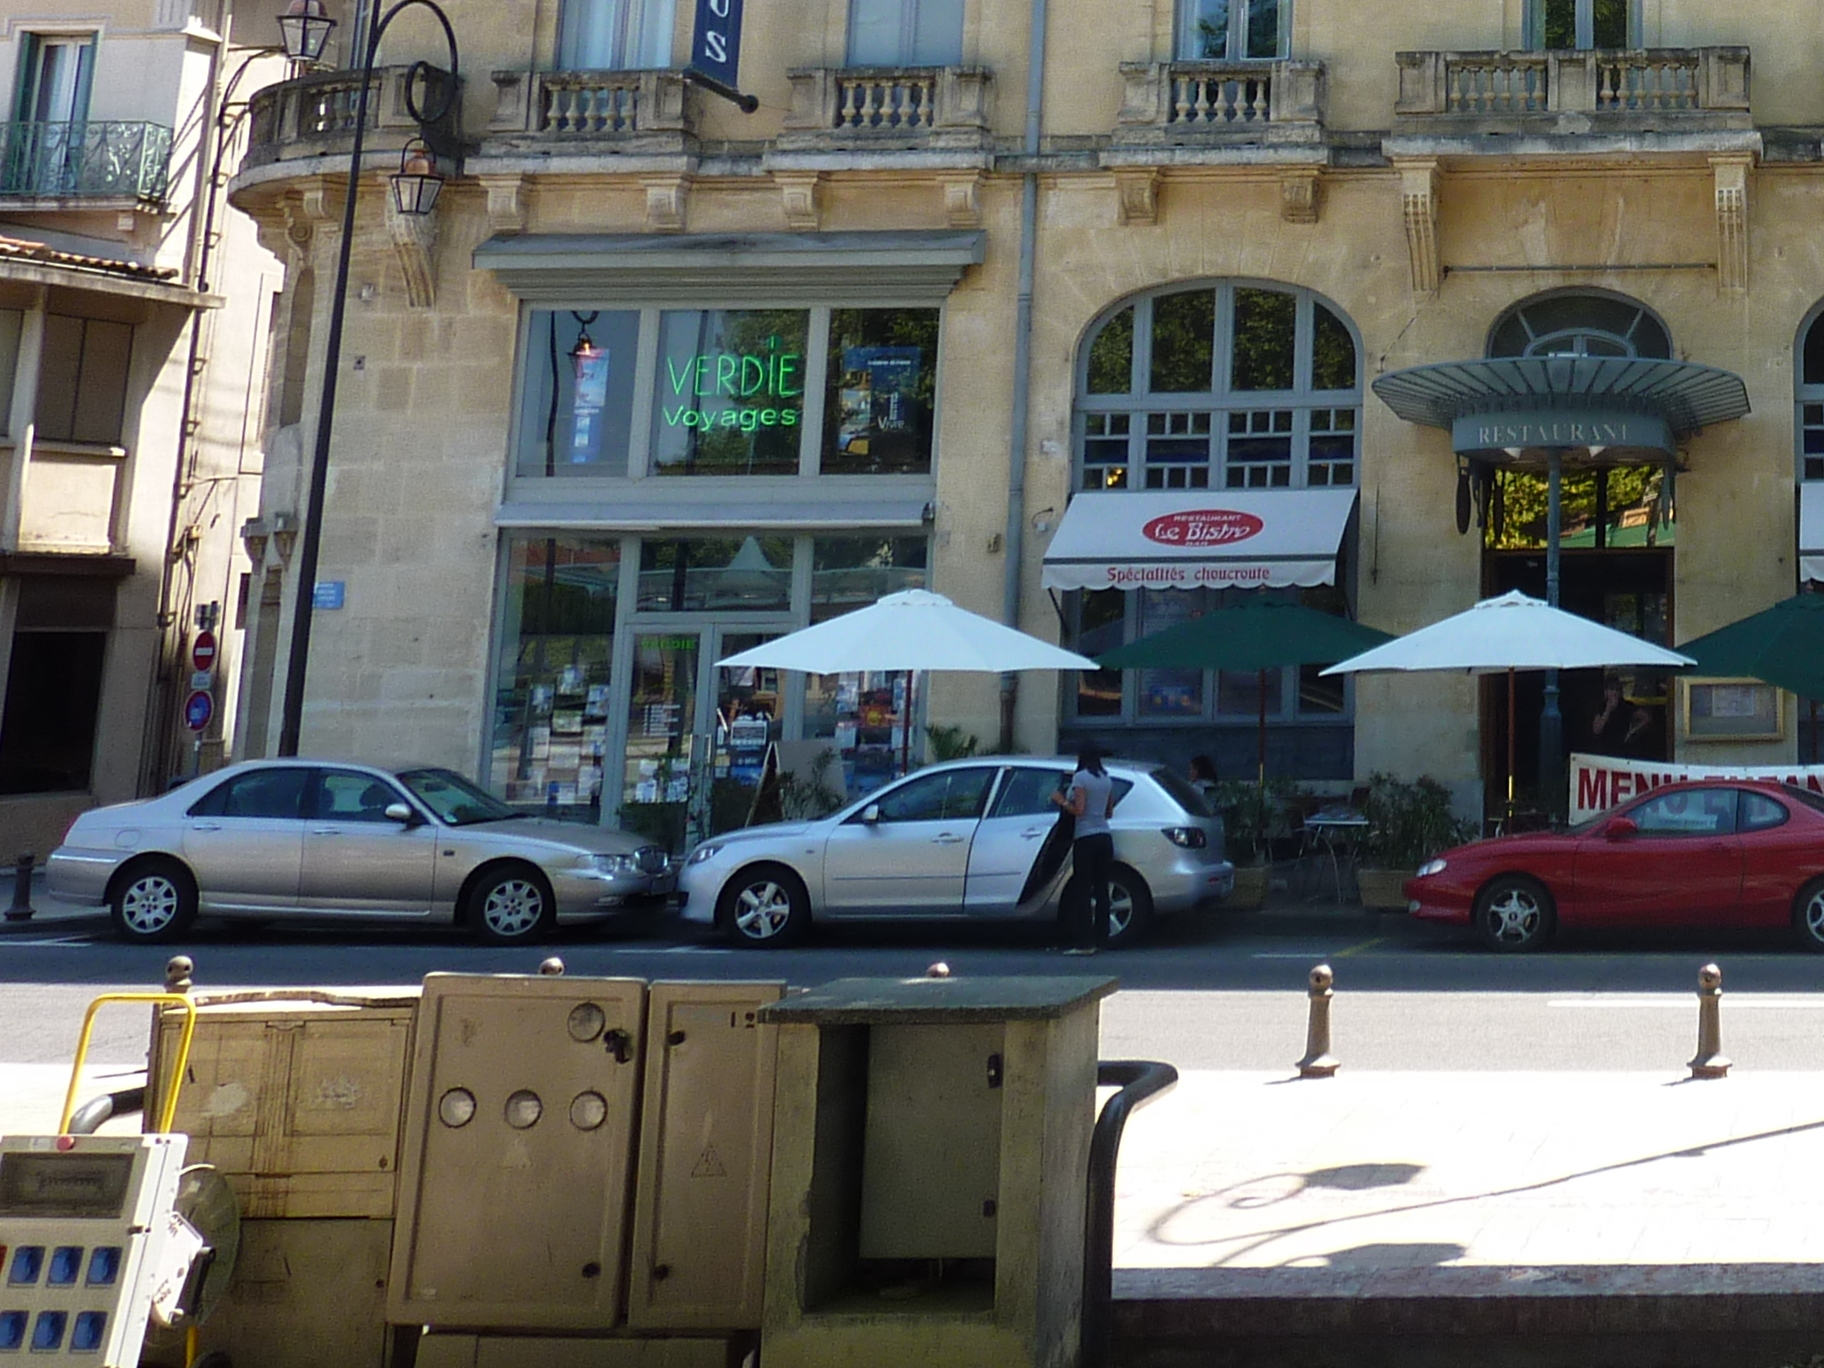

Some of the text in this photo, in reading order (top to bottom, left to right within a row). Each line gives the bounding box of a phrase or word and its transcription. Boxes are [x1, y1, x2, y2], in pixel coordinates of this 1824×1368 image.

[662, 405, 797, 432] Voyages
[1478, 423, 1628, 444] RESTAURANT
[1173, 514, 1242, 522] RESTAURANT
[1154, 521, 1251, 541] Le Bistro
[1106, 566, 1270, 583] Spécialités choucroute
